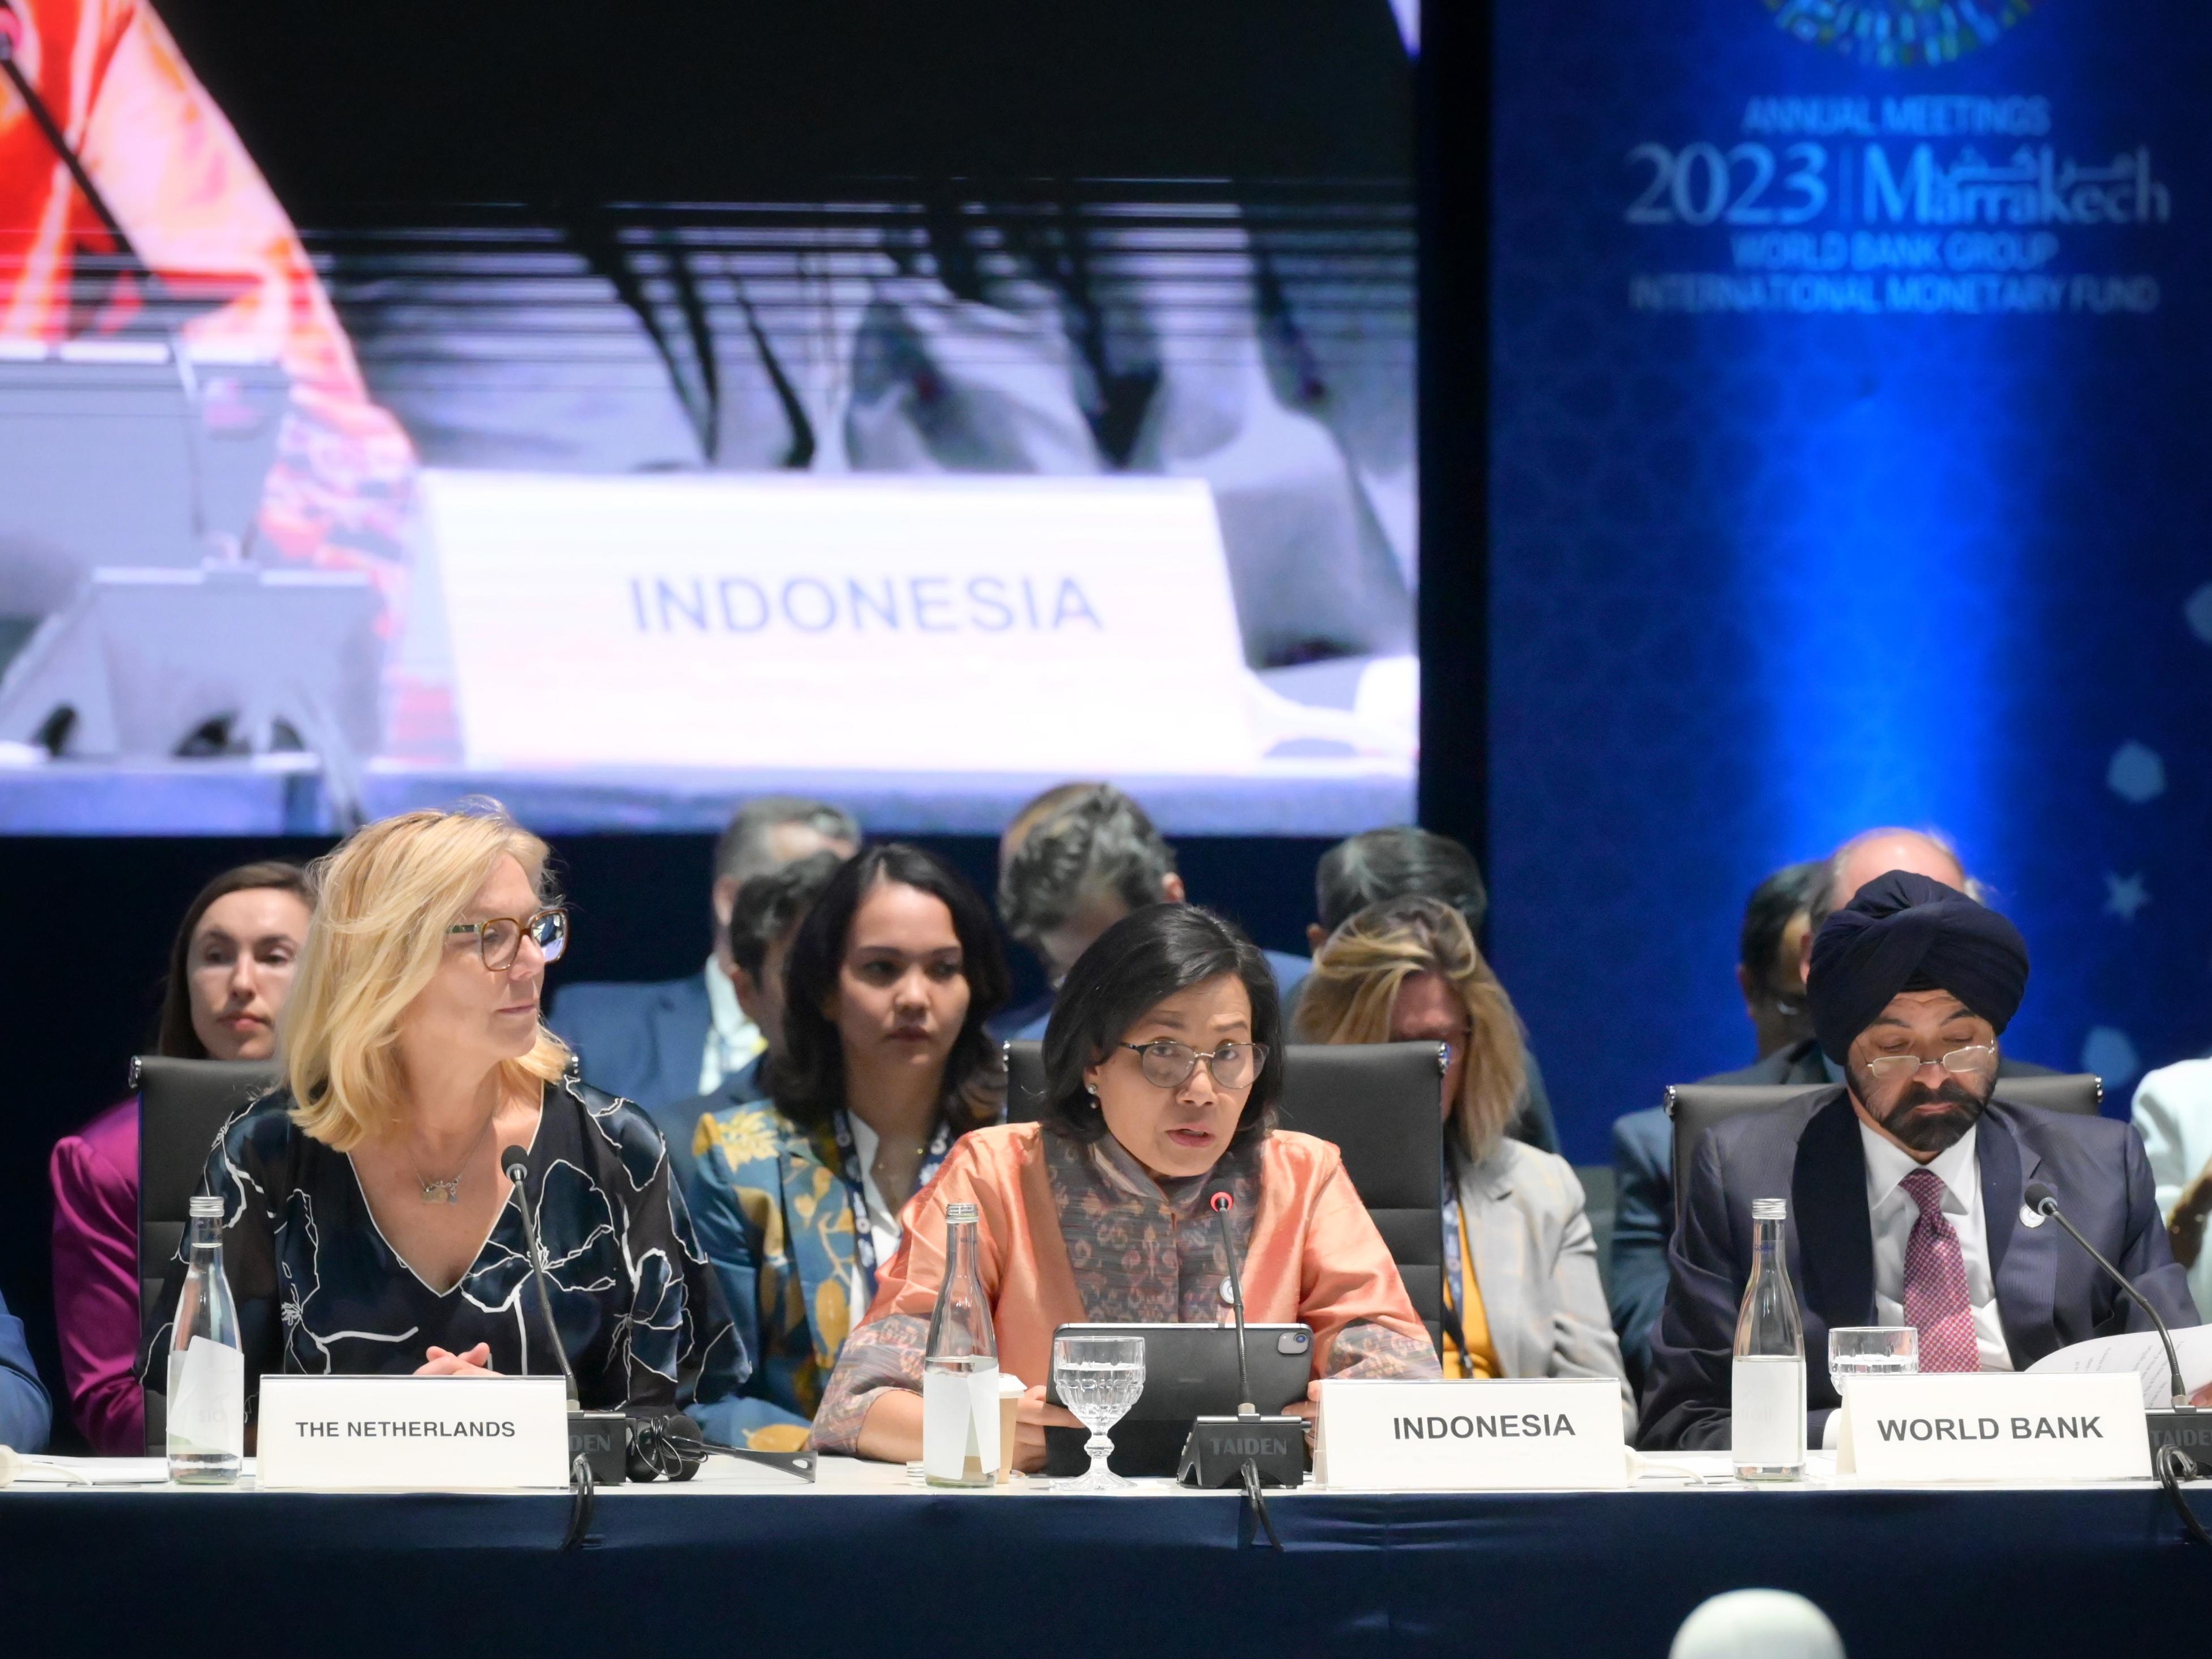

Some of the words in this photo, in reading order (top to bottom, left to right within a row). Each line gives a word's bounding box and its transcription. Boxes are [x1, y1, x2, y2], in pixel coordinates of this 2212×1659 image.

[1742, 95, 1877, 135] ANNUAL
[1881, 95, 2051, 135] MEETINGS
[1623, 142, 1829, 225] 2023
[1863, 143, 2171, 224] Marrakech
[1731, 231, 1848, 270] WORLD
[1851, 231, 1944, 271] BANK
[1946, 230, 2060, 270] GROUP
[1629, 274, 1880, 312] INTERNATIONAL
[1885, 274, 2067, 313] MONETARY
[2070, 275, 2161, 312] FUND
[630, 575, 1103, 633] INDONESIA
[296, 1422, 340, 1438] THE
[348, 1421, 516, 1438] NETHERLANDS
[1393, 1414, 1576, 1441] INDONESIA
[1877, 1418, 2000, 1442] WORLD
[2010, 1416, 2104, 1439] BANK
[2149, 1429, 2212, 1447] TAIDE
[1210, 1438, 1287, 1455] TAIDEN
